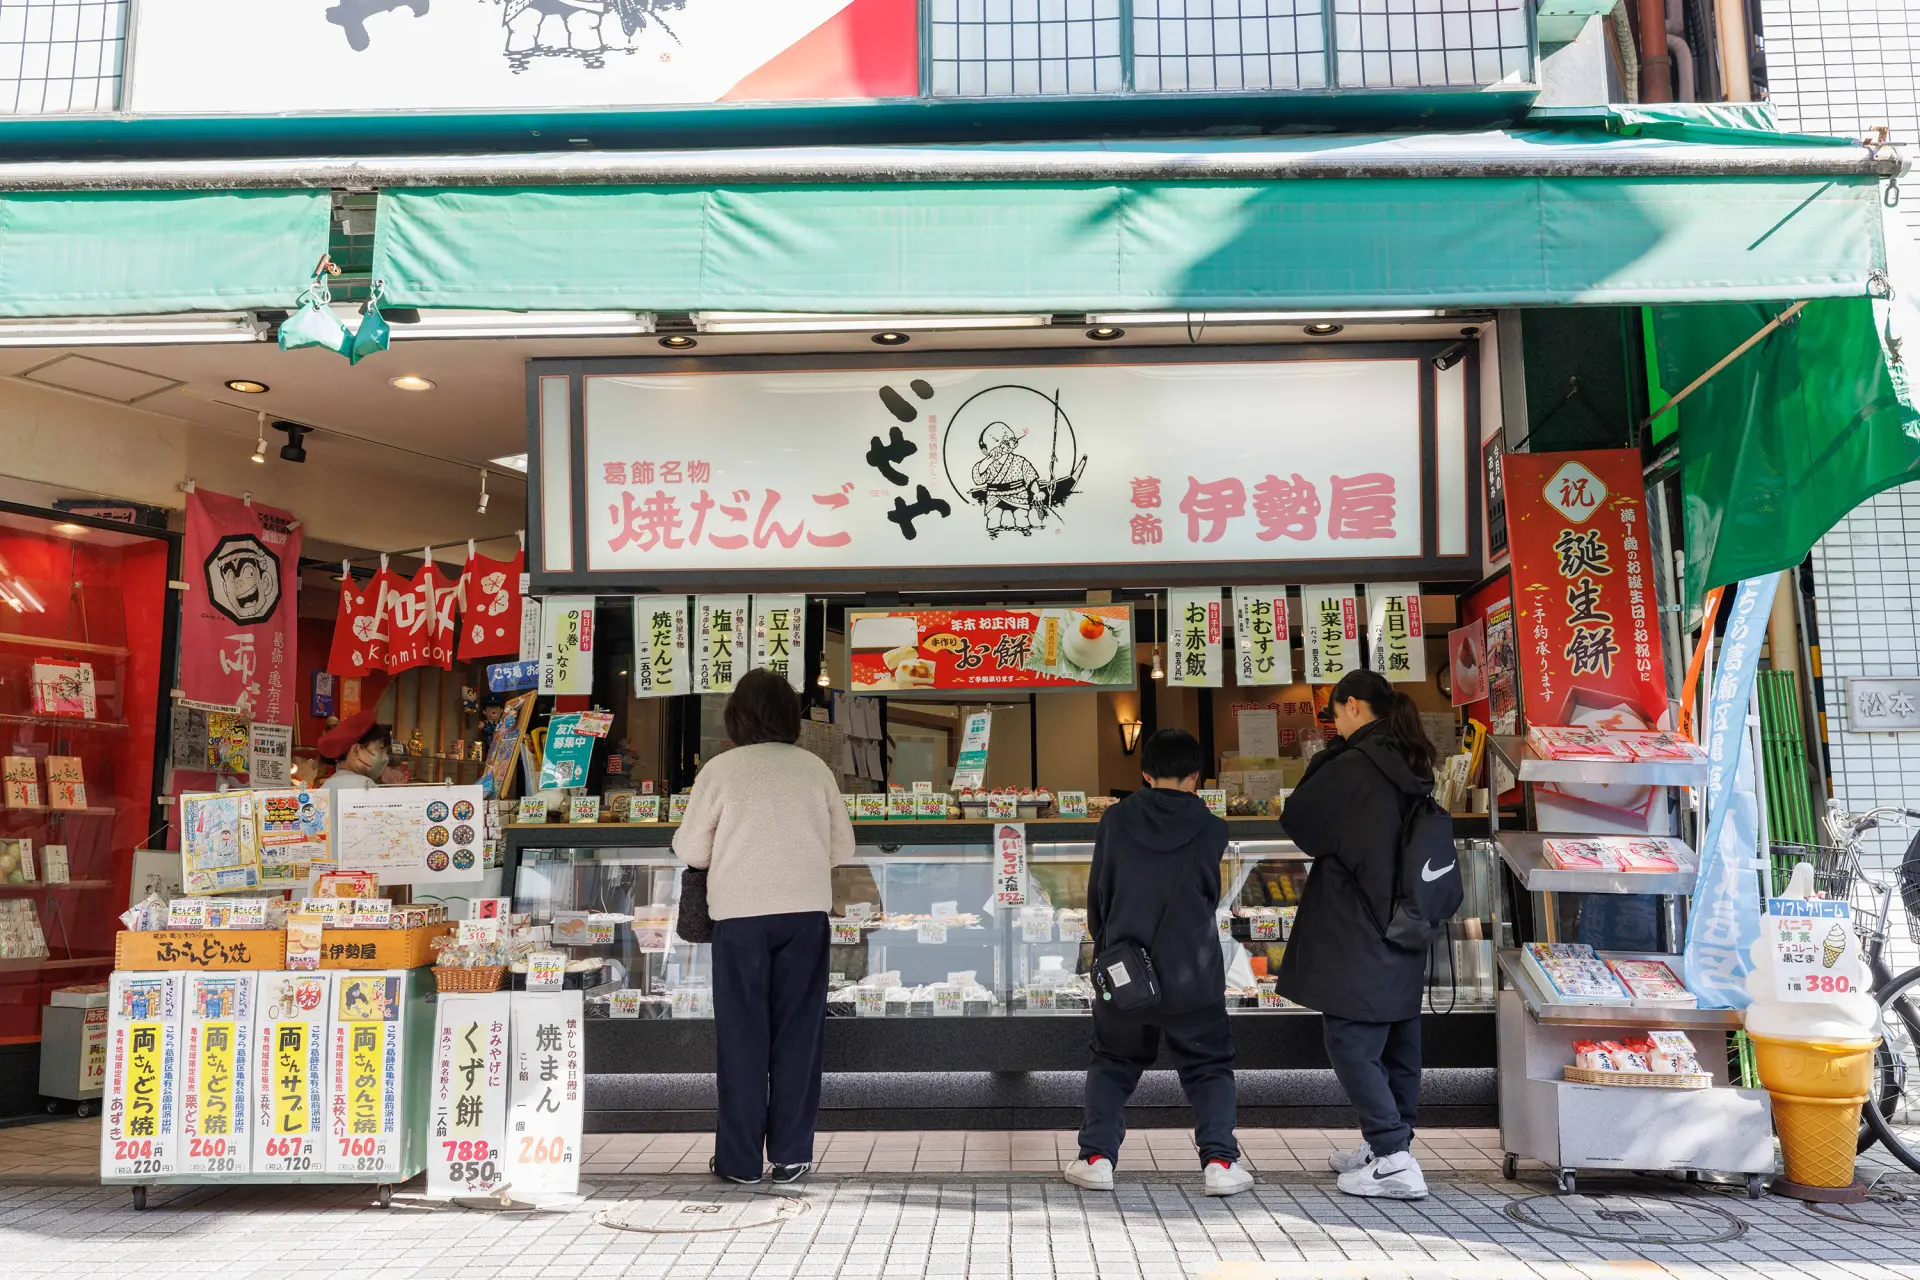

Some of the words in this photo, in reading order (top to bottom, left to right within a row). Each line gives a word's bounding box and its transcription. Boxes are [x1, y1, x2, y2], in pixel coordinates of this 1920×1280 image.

[603, 460, 711, 486] 葛飾名物
[1559, 477, 1595, 508] 祝
[869, 489, 890, 497] ISEYA
[1129, 475, 1163, 545] 葛飾
[1179, 472, 1397, 544] 伊勢屋
[607, 482, 855, 553] 焼だんご
[1553, 529, 1620, 679] 誕生餅
[1621, 508, 1651, 682] 満1歳のお誕生日のお祝いに
[567, 610, 579, 646] のり巻
[582, 611, 591, 650] 毎日手作り
[675, 610, 684, 649] 伊勢屋名物
[736, 609, 744, 648] 伊勢屋名物
[792, 608, 801, 647] 伊勢屋名物
[951, 619, 976, 631] 年末
[979, 617, 1030, 630] お正月用
[1210, 604, 1219, 643] 毎日手作り
[1251, 599, 1275, 673] おむすび
[1275, 600, 1285, 639] 毎日手作り
[1321, 598, 1343, 673] 山菜おこわ
[1345, 599, 1353, 638] 毎日手作り
[1385, 596, 1410, 671] 五目ご飯
[1409, 597, 1418, 636] 毎日手作り
[652, 611, 673, 685] 焼だんご
[713, 609, 732, 684] 塩大福
[931, 637, 957, 647] 手作り
[955, 635, 1032, 670] お餅
[1185, 602, 1207, 676] お赤飯
[1533, 594, 1555, 702] ご予約承ります
[494, 665, 522, 680] こち亀
[557, 643, 569, 681] いなり
[968, 675, 1015, 684] ご予約承ります
[1859, 690, 1915, 718] 松本
[554, 737, 586, 749] 募集中
[574, 800, 596, 808] いなり
[1776, 902, 1844, 917] ソフトクリーム
[1778, 919, 1813, 931] バニラ
[329, 943, 376, 959] 伊勢屋
[1777, 943, 1820, 953] チョコレート
[1780, 931, 1811, 943] 抹茶
[534, 962, 560, 970] 焼まん
[1782, 953, 1815, 963] 黒ごま
[1805, 975, 1857, 993] 380円
[113, 1029, 124, 1094] 亀有地域限定販売
[188, 1027, 198, 1092] 亀有地域限定販売
[262, 1027, 270, 1092] 亀有地域限定販売
[335, 1028, 345, 1091] 亀有地域限定販売
[488, 1020, 503, 1087] おみやげに
[536, 1023, 562, 1114] 焼まん
[567, 1018, 578, 1101] 懐かしの春日饅頭
[130, 1027, 157, 1136] 両さんどら焼
[204, 1027, 229, 1135] 両さんどら焼
[279, 1026, 303, 1132] 両さんサブレ
[353, 1026, 377, 1134] 両さんめんこ焼
[456, 1021, 485, 1128] くず餅
[110, 1098, 124, 1140] あずき
[185, 1095, 198, 1137] 栗どら
[260, 1094, 271, 1127] 五枚入り
[332, 1094, 345, 1137] 五枚入り
[436, 1106, 448, 1137] 二人前
[442, 1140, 498, 1161] 788円
[449, 1161, 502, 1182] 850円
